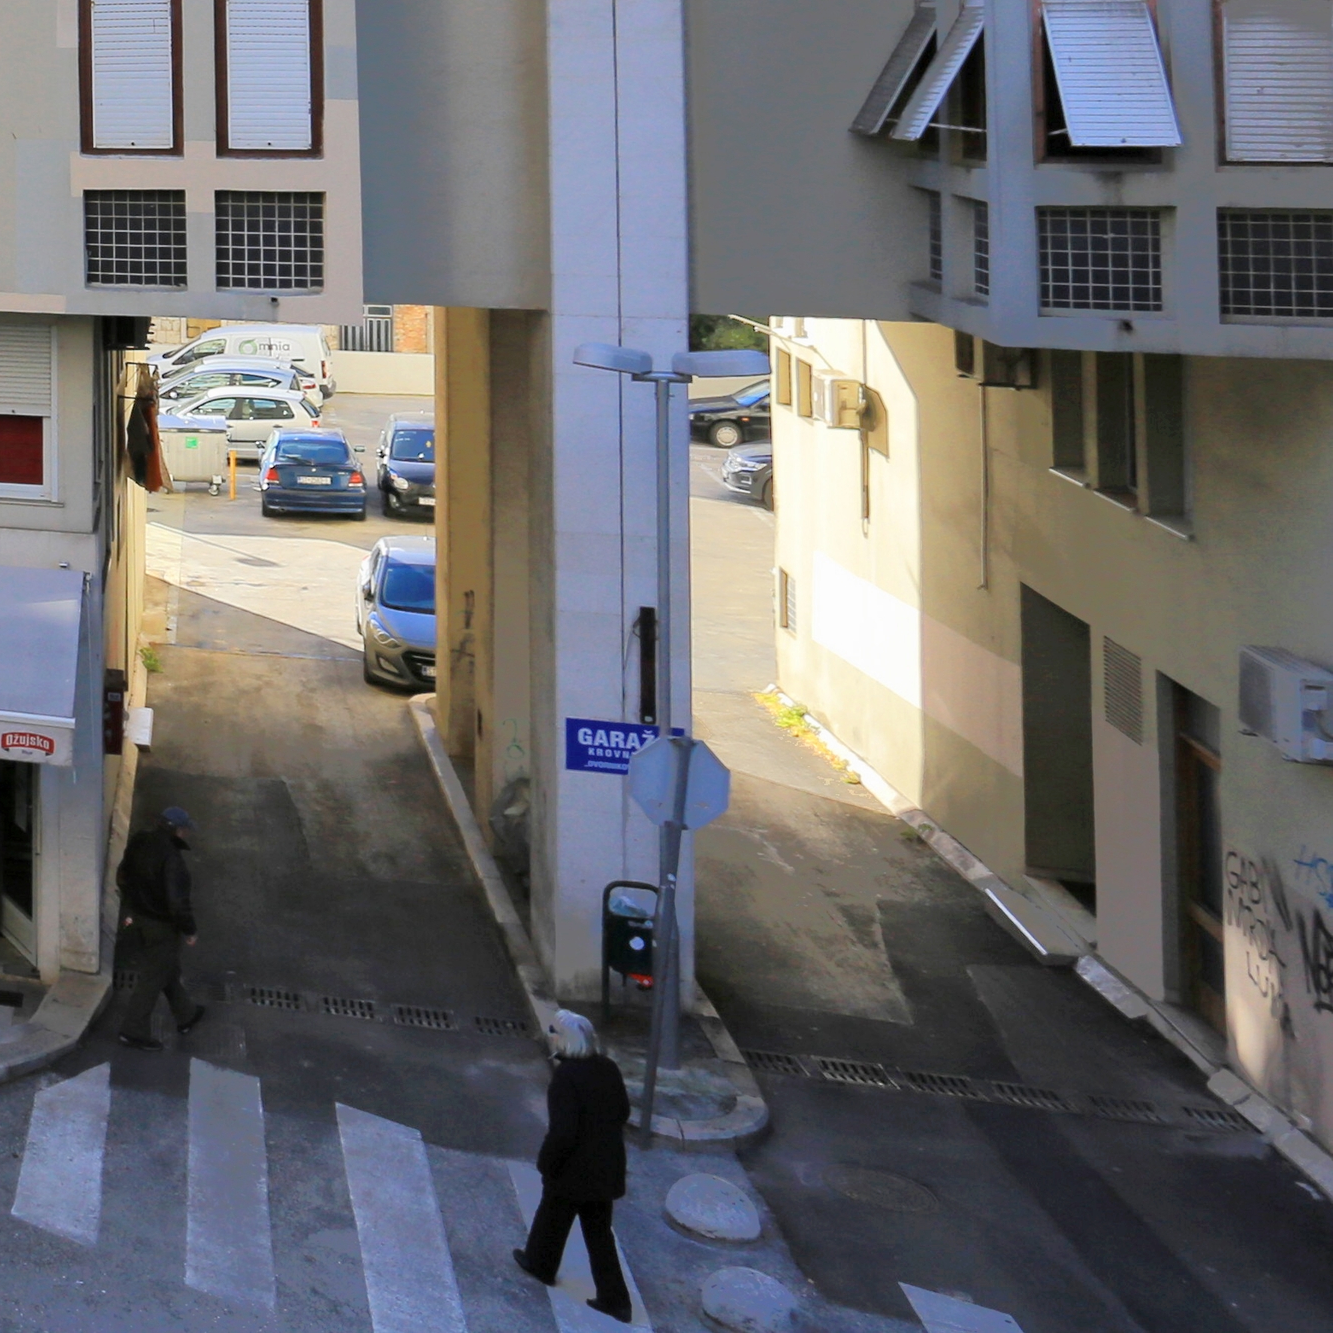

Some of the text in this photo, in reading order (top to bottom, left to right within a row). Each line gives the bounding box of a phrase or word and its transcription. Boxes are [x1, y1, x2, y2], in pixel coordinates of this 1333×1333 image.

[6, 734, 50, 749] Ožujsko
[577, 727, 655, 750] GARAŽ
[588, 747, 630, 759] KROVN
